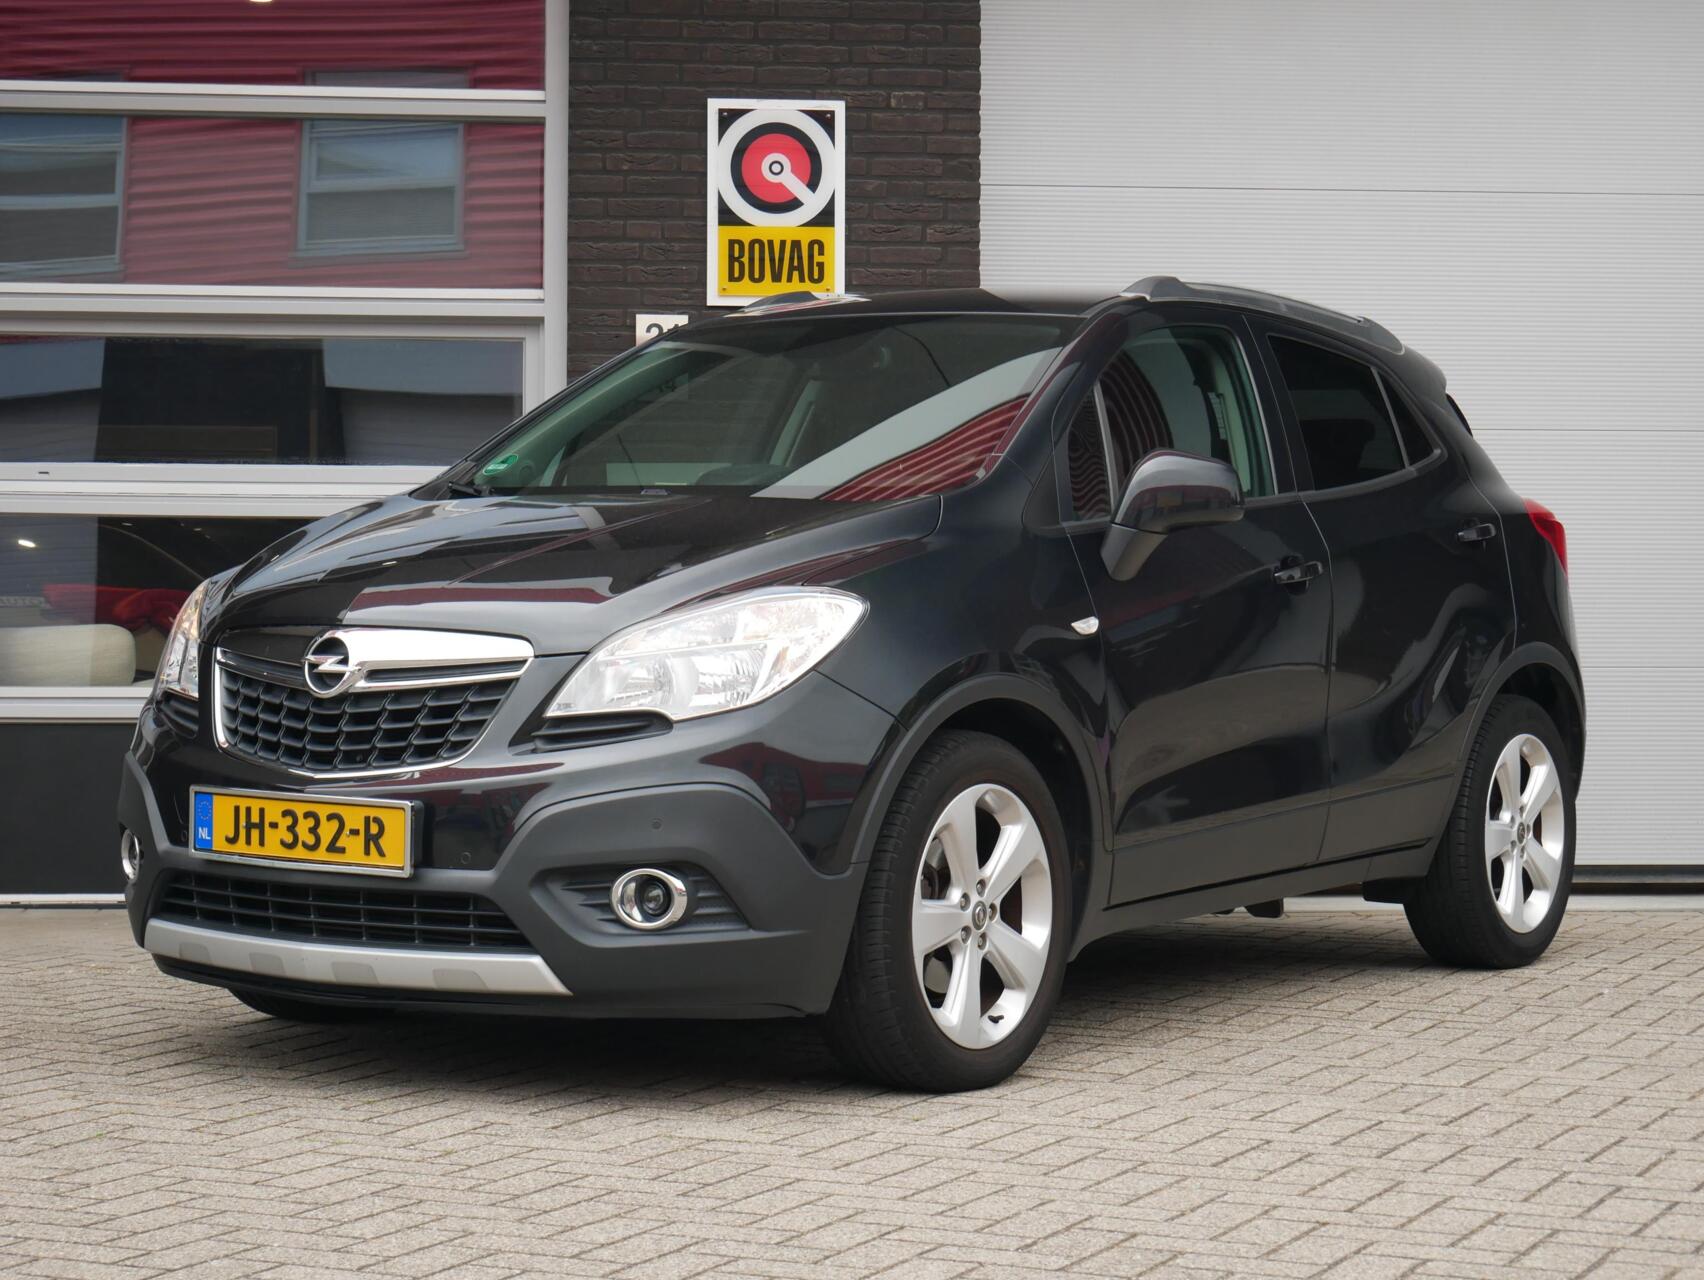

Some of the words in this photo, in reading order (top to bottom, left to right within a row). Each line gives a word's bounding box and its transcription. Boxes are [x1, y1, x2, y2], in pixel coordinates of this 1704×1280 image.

[727, 238, 825, 284] BOVAG
[198, 827, 211, 841] NL
[224, 805, 386, 858] JH-332-R
